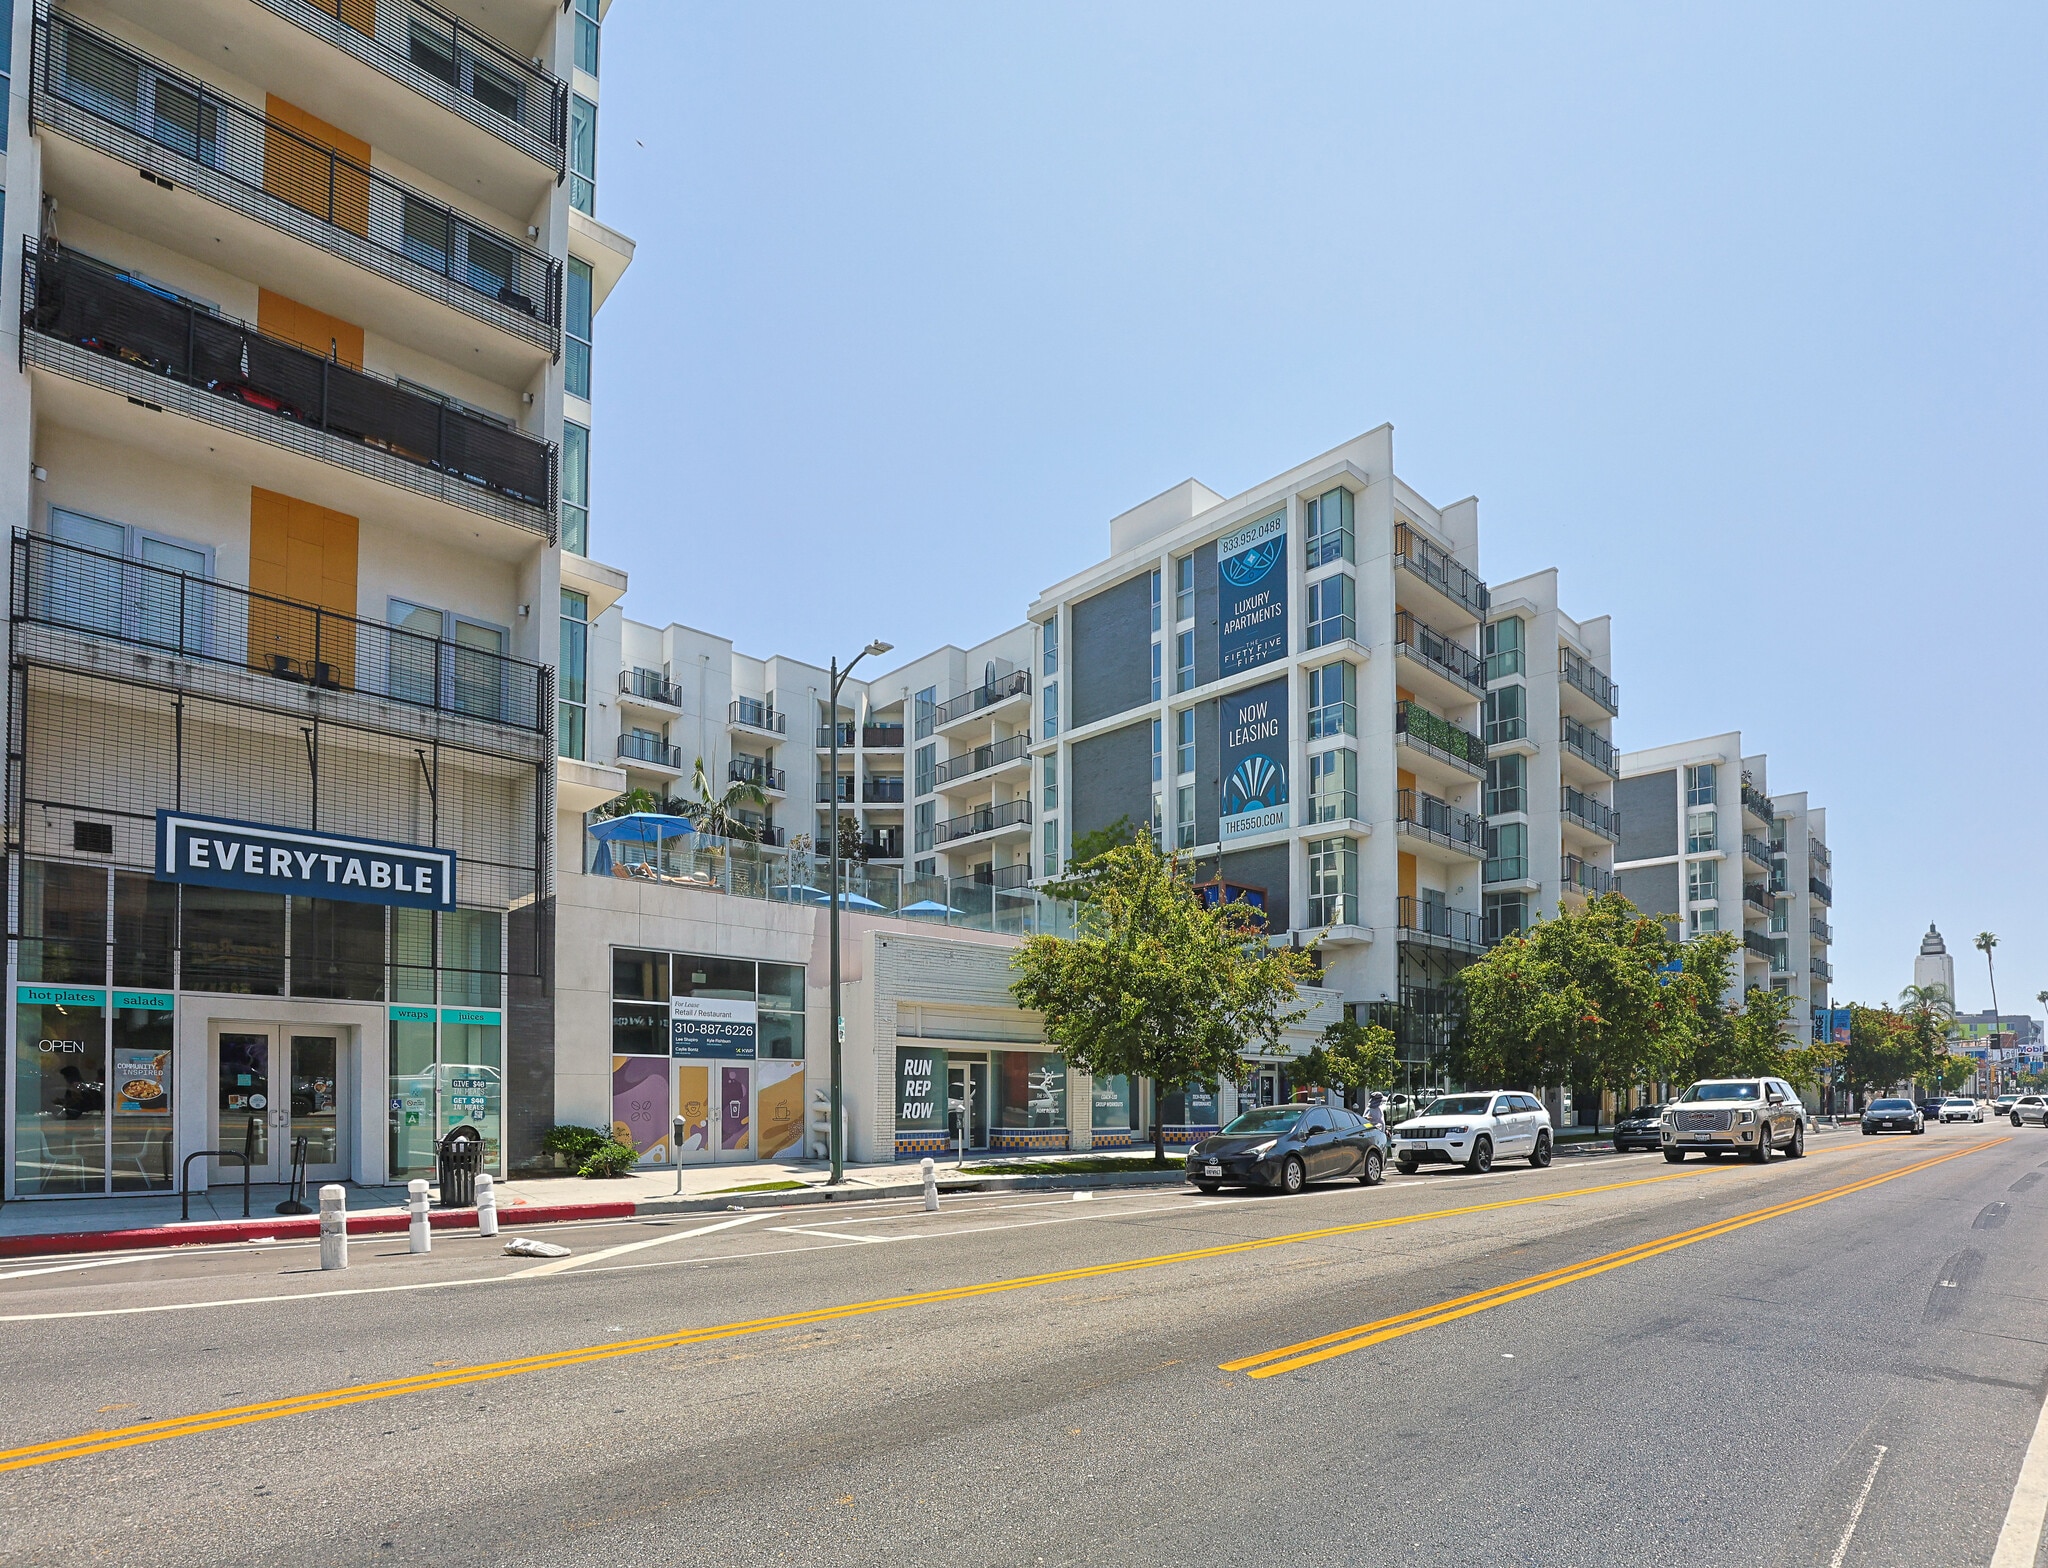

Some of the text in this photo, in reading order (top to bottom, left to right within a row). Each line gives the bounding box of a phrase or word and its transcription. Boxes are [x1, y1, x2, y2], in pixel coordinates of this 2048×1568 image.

[1223, 518, 1281, 553] 833.952.0488
[1234, 590, 1270, 615] LUXURY
[1224, 602, 1282, 635] APARTMENTS
[1224, 637, 1282, 663] FIFTY FIVE
[1246, 639, 1259, 648] THE
[1237, 650, 1268, 667] FIFTY
[1239, 701, 1268, 725] NOW
[1229, 718, 1279, 748] LEASING
[1226, 811, 1284, 834] THE5550.COM
[188, 836, 434, 894] EVERYTABLE
[28, 989, 96, 1003] hot plates
[123, 996, 165, 1007] salads
[398, 1010, 429, 1020] wraps
[458, 1012, 485, 1022] juices
[698, 1010, 732, 1018] Restaurant
[674, 1022, 754, 1037] 310-887-6226
[1814, 1014, 1825, 1043] RINGE
[38, 1039, 85, 1053] OPEN
[2017, 1045, 2045, 1053] Mobil
[903, 1059, 933, 1076] RUN
[453, 1080, 485, 1088] GIVE $40
[464, 1088, 485, 1096] MEALS
[905, 1080, 932, 1097] REP
[902, 1102, 934, 1119] ROW
[407, 1115, 417, 1124] A
